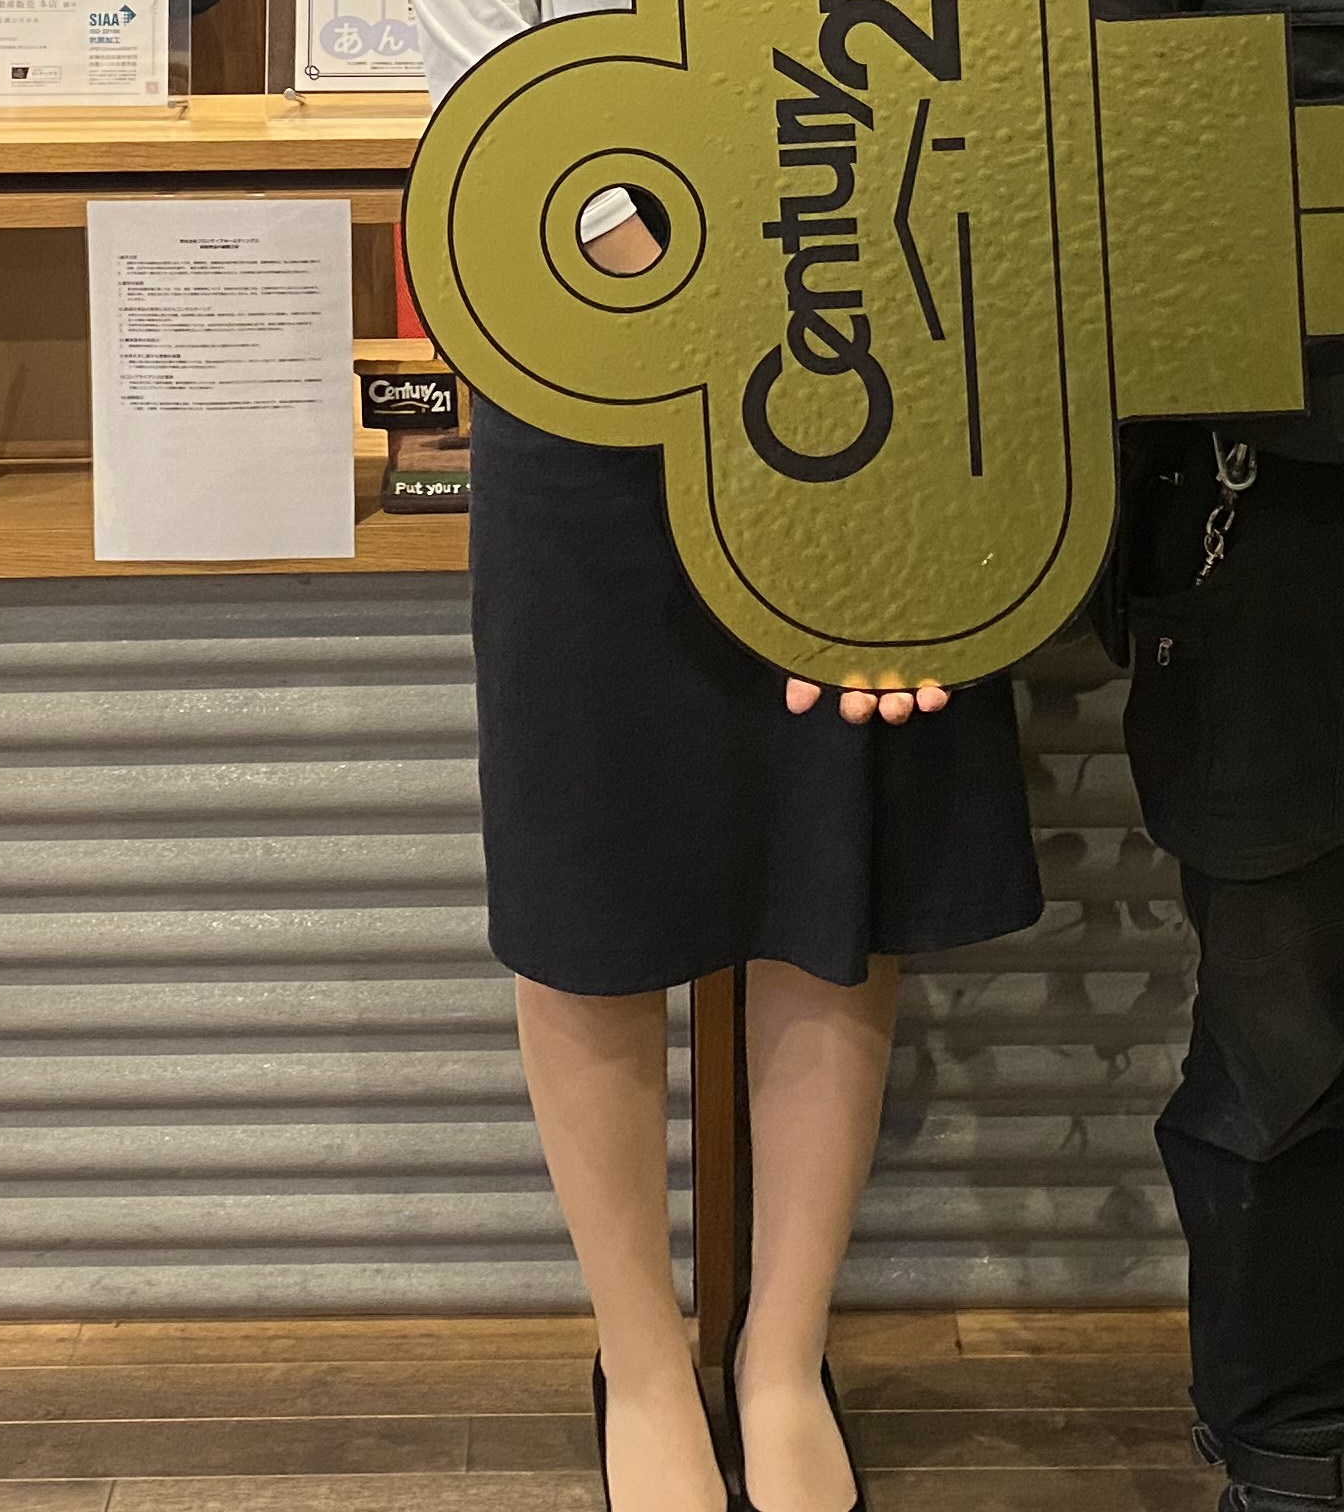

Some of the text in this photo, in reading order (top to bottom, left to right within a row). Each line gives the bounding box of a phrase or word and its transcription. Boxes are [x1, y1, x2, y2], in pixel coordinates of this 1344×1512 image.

[89, 13, 119, 27] SIAA
[368, 379, 452, 413] Century 21
[394, 481, 462, 496] Put your
